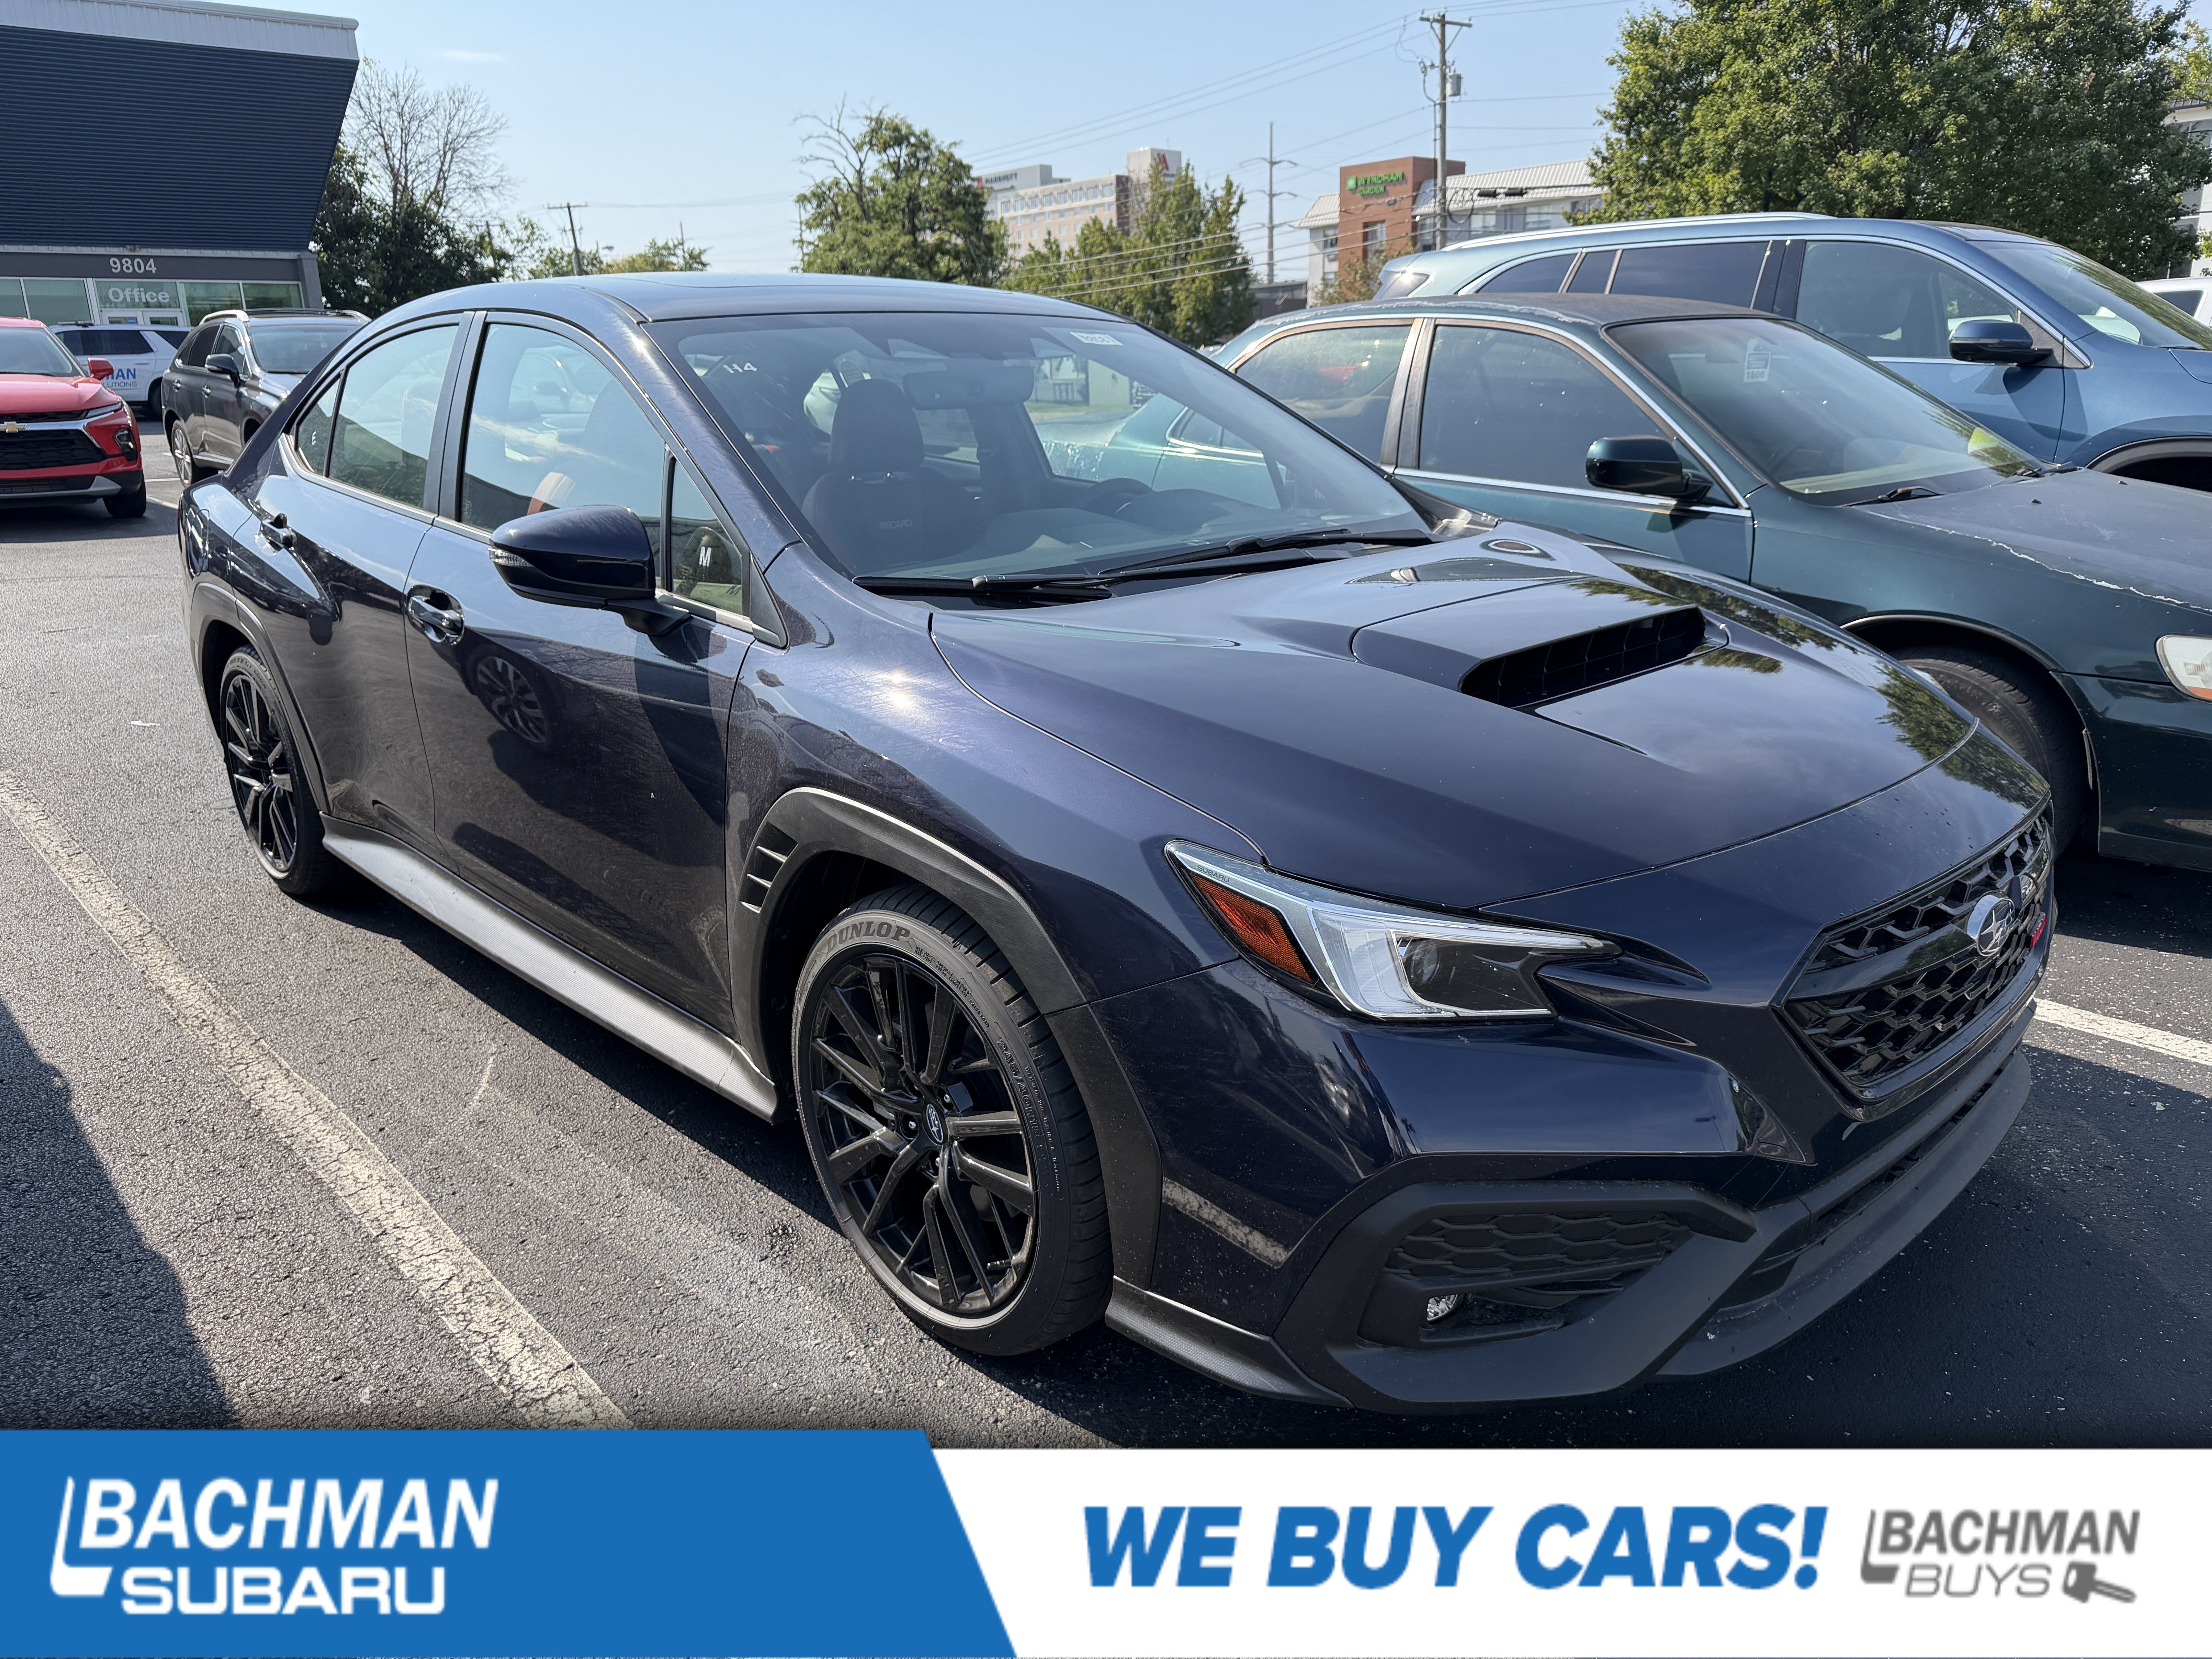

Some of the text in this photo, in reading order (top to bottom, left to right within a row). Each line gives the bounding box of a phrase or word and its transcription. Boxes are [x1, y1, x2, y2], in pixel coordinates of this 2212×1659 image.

[110, 258, 157, 273] 9804
[108, 287, 170, 303] Office
[879, 519, 913, 530] RECARO
[699, 546, 712, 567] M
[1197, 865, 1230, 883] SUBARU
[826, 921, 910, 955] DUNLOP
